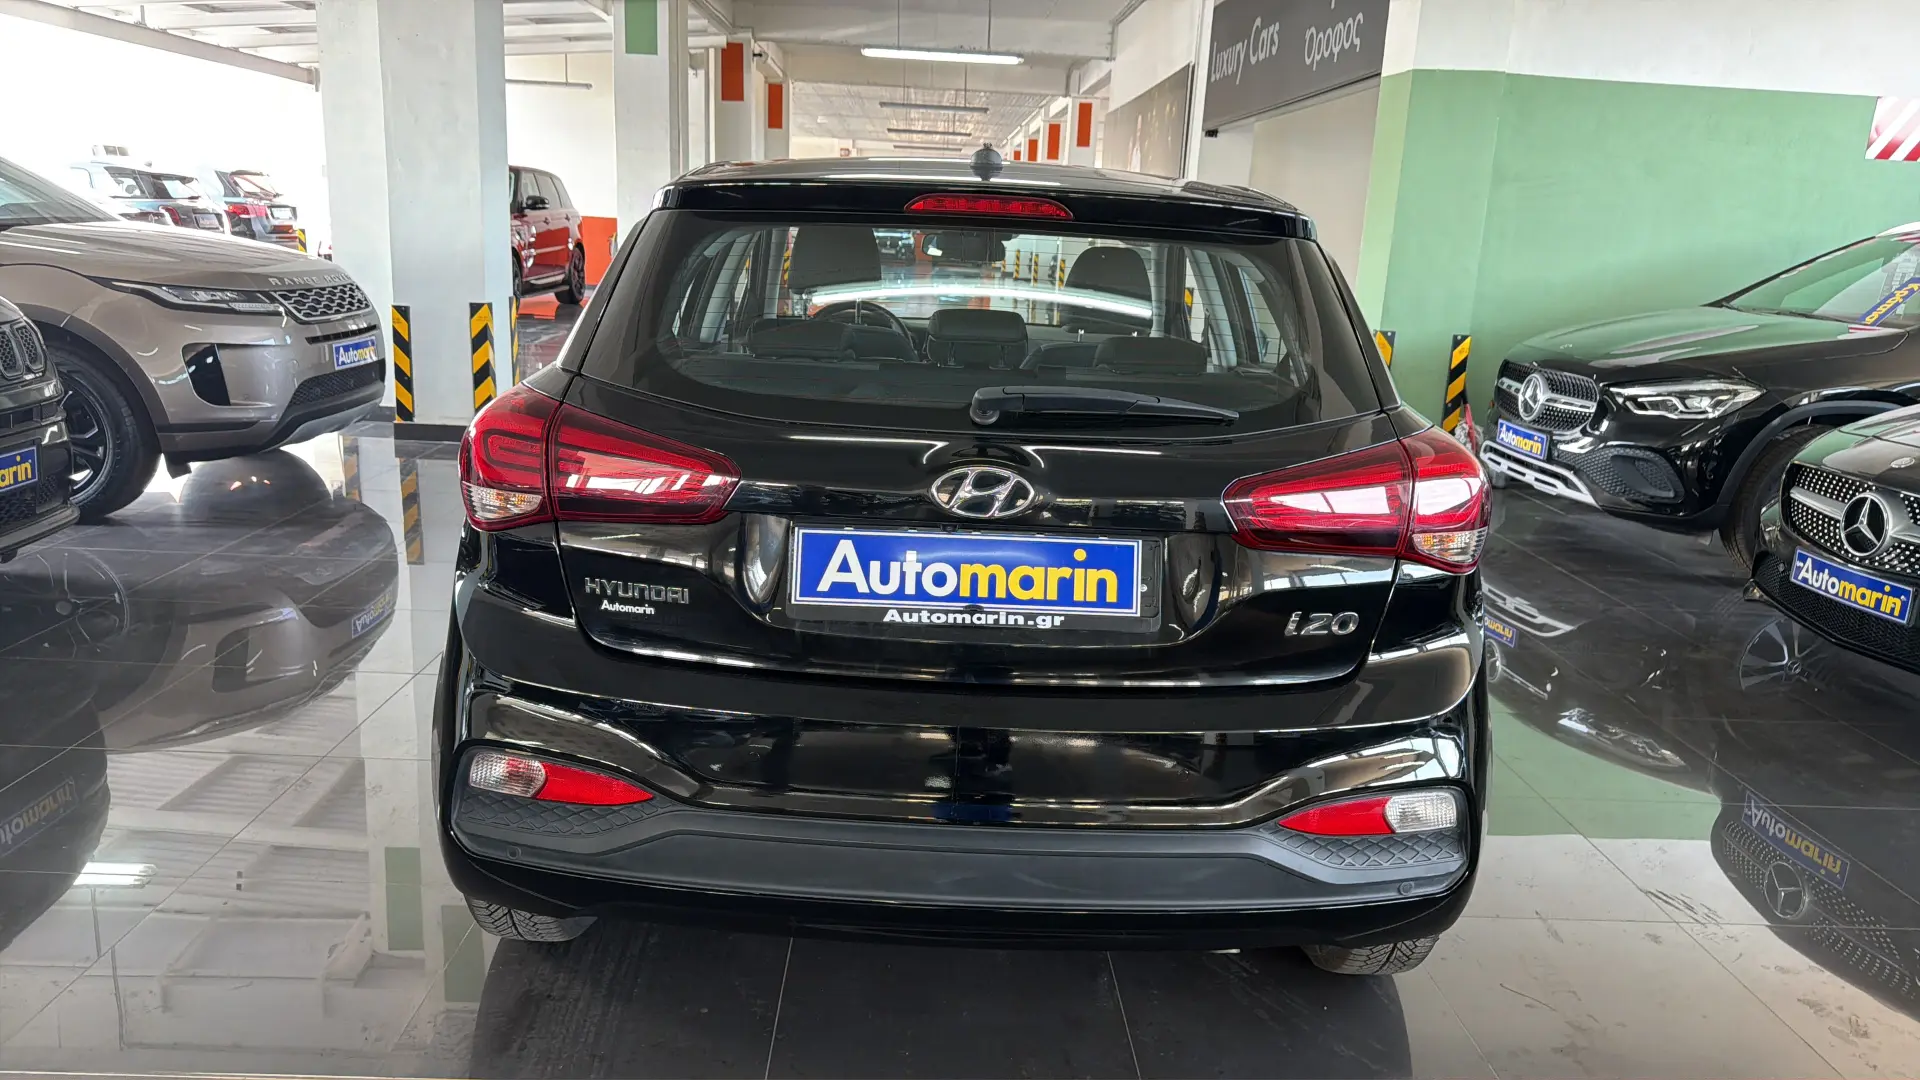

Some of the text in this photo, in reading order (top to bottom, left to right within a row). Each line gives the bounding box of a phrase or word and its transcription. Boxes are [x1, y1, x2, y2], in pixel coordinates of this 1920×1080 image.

[1211, 16, 1280, 85] Luxury Cars
[1499, 423, 1542, 455] Automarin
[816, 539, 1118, 603] Automarin
[1798, 557, 1902, 617] Automarin
[584, 577, 689, 605] HYUNDAI
[600, 599, 655, 615] Automarin
[882, 608, 1065, 629] Automarin.gr
